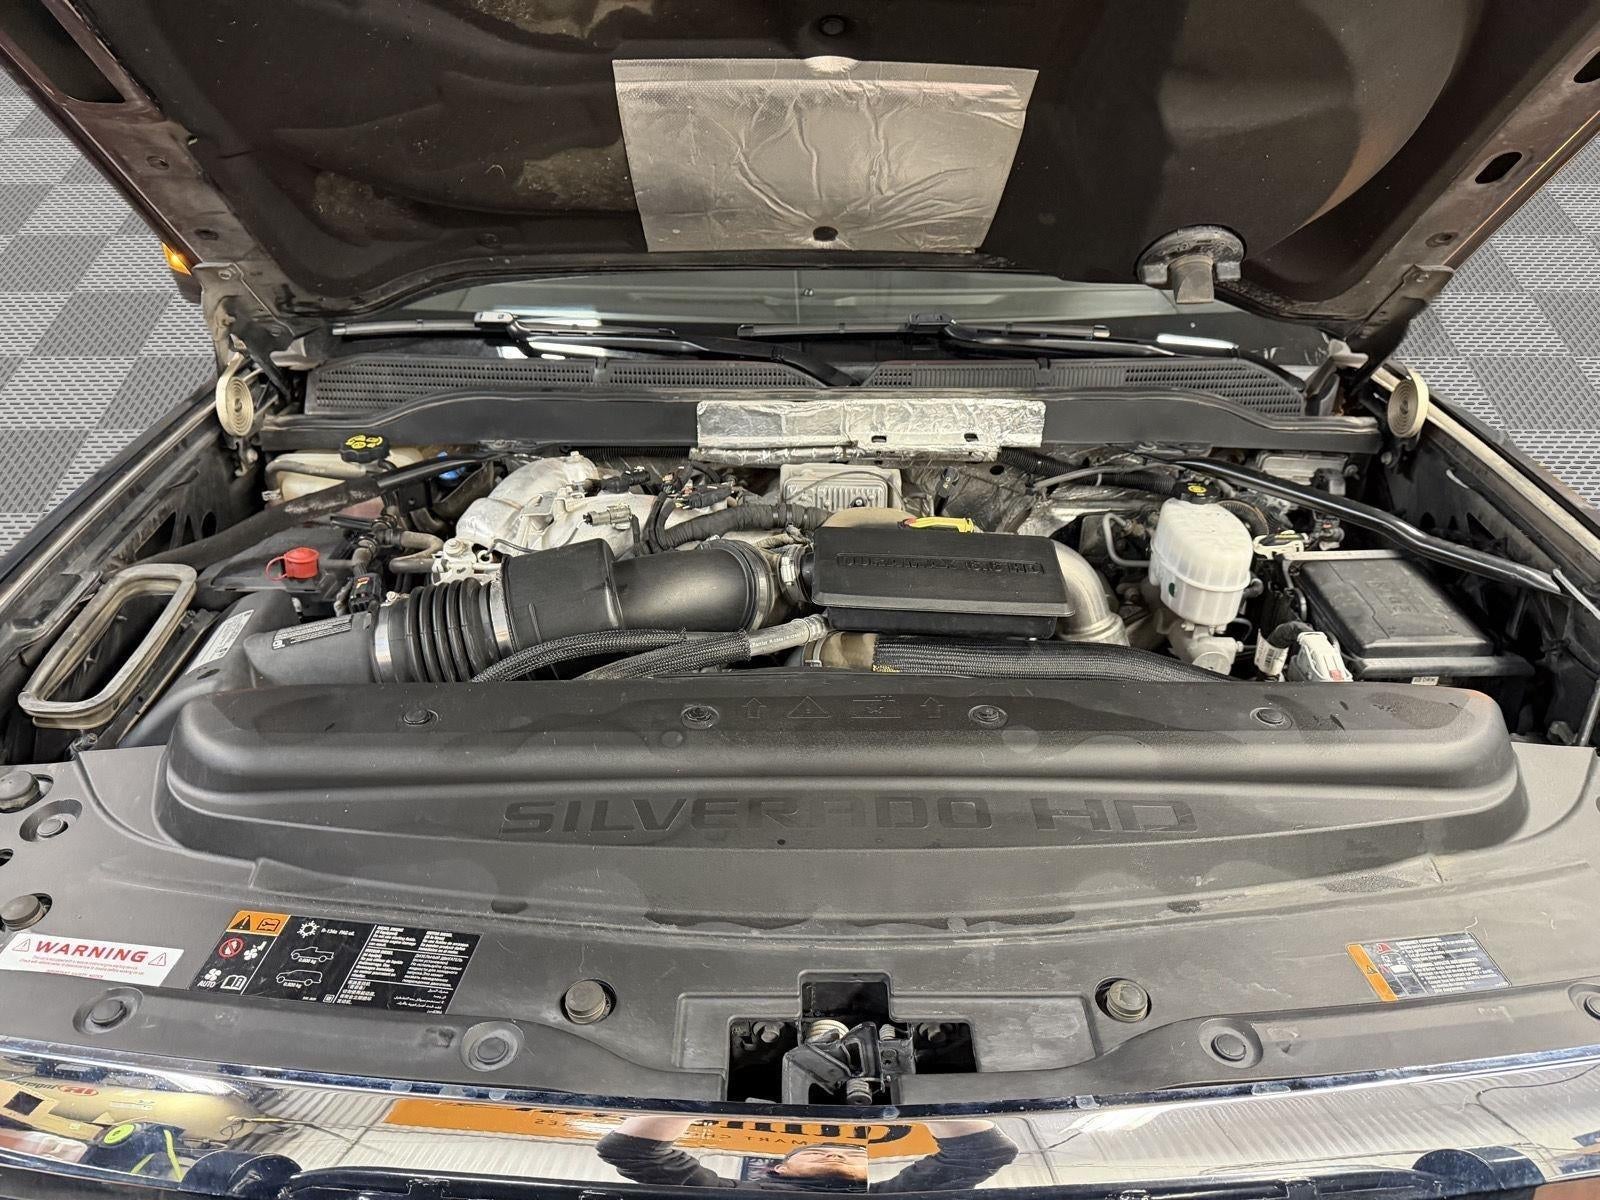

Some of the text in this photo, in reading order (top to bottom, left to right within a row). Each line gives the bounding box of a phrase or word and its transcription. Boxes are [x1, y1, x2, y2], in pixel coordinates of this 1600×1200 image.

[501, 797, 1199, 834] SILVERADO HD
[35, 940, 149, 963] WARNING
